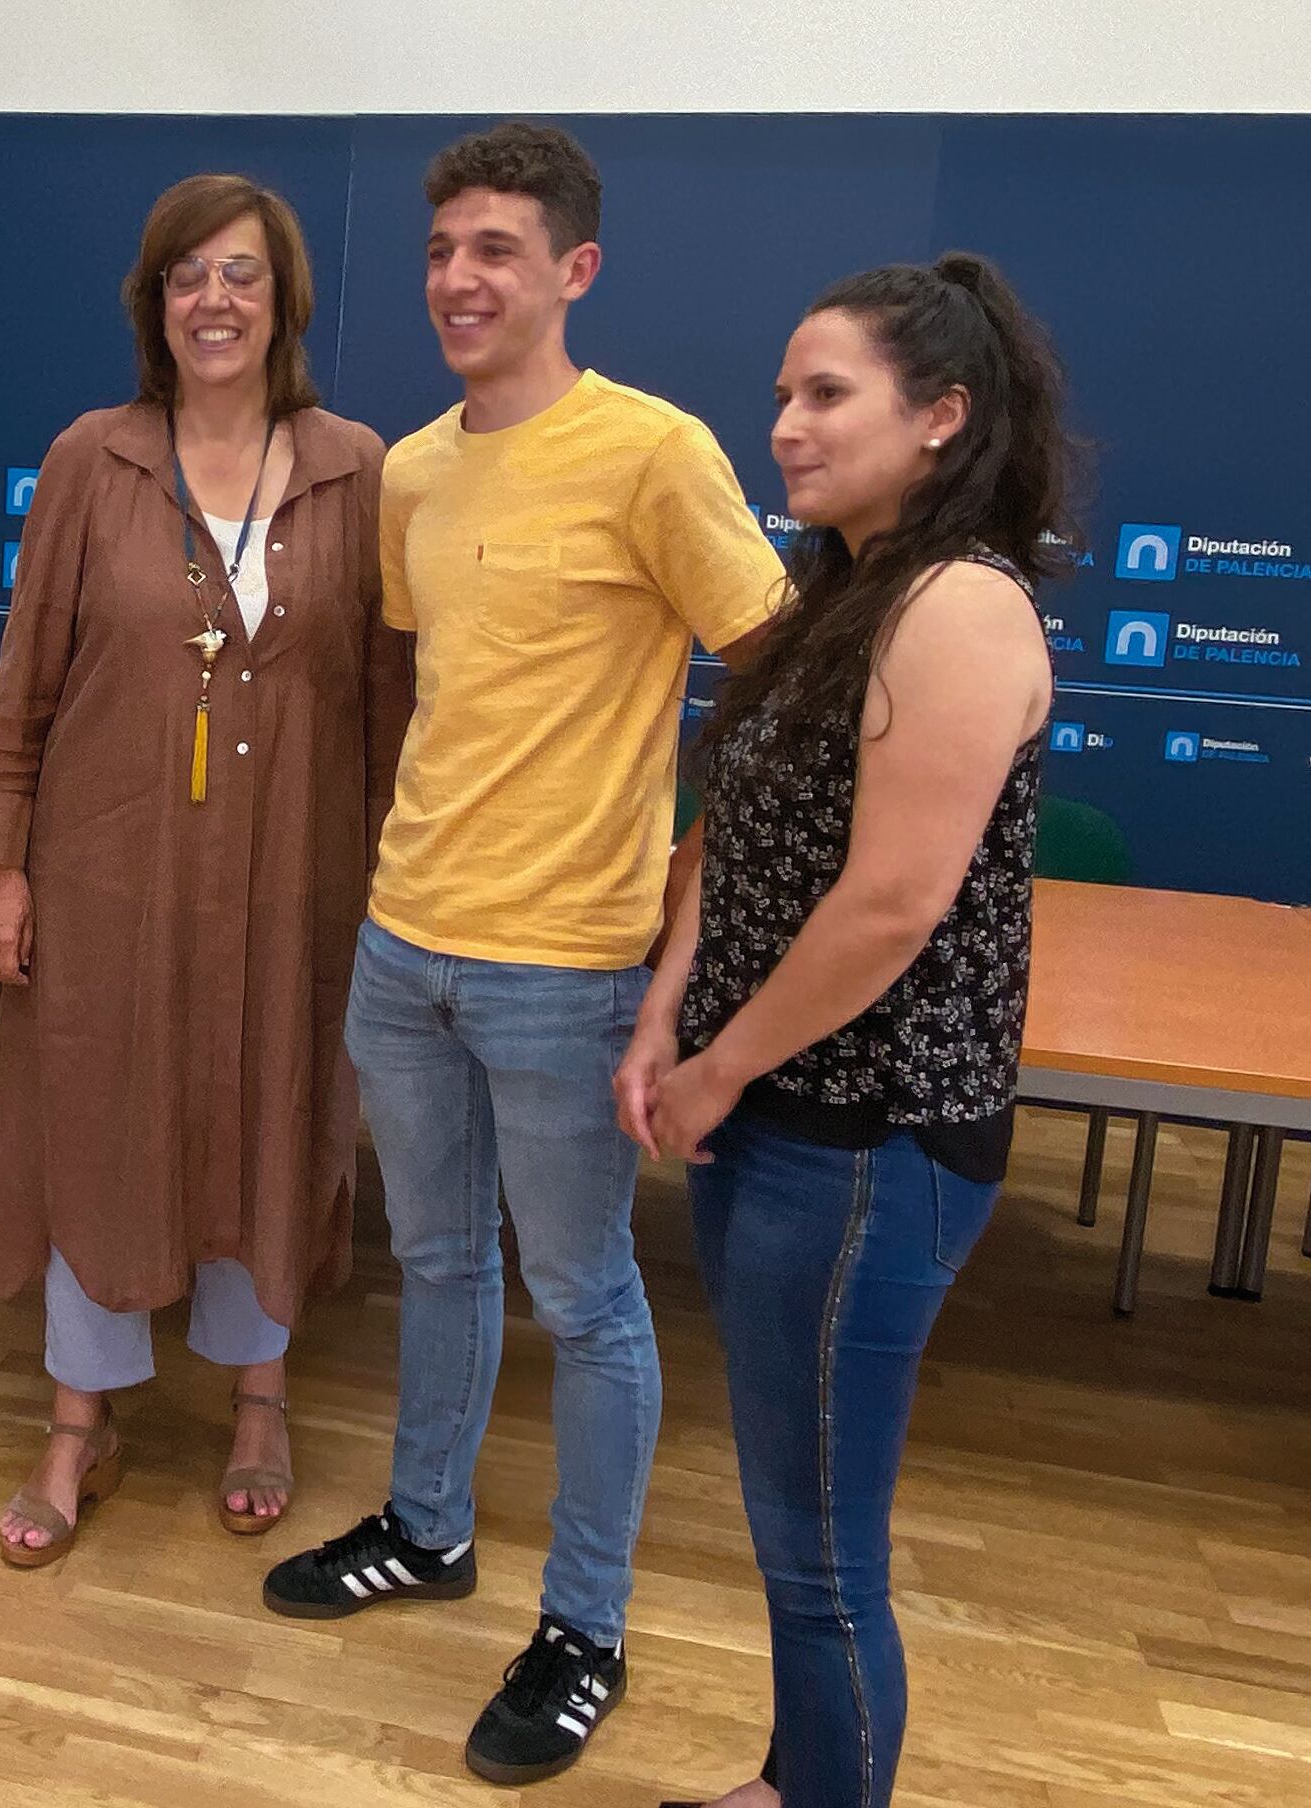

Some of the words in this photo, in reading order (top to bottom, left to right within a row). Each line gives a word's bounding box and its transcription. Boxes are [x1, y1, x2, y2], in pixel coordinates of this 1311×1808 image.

[1188, 536, 1292, 557] Diputación
[1186, 559, 1210, 573] DE
[1217, 560, 1311, 578] PALENCIA
[1176, 624, 1279, 644] Diputación
[1174, 645, 1200, 660] DE
[1205, 646, 1301, 667] PALENCIA
